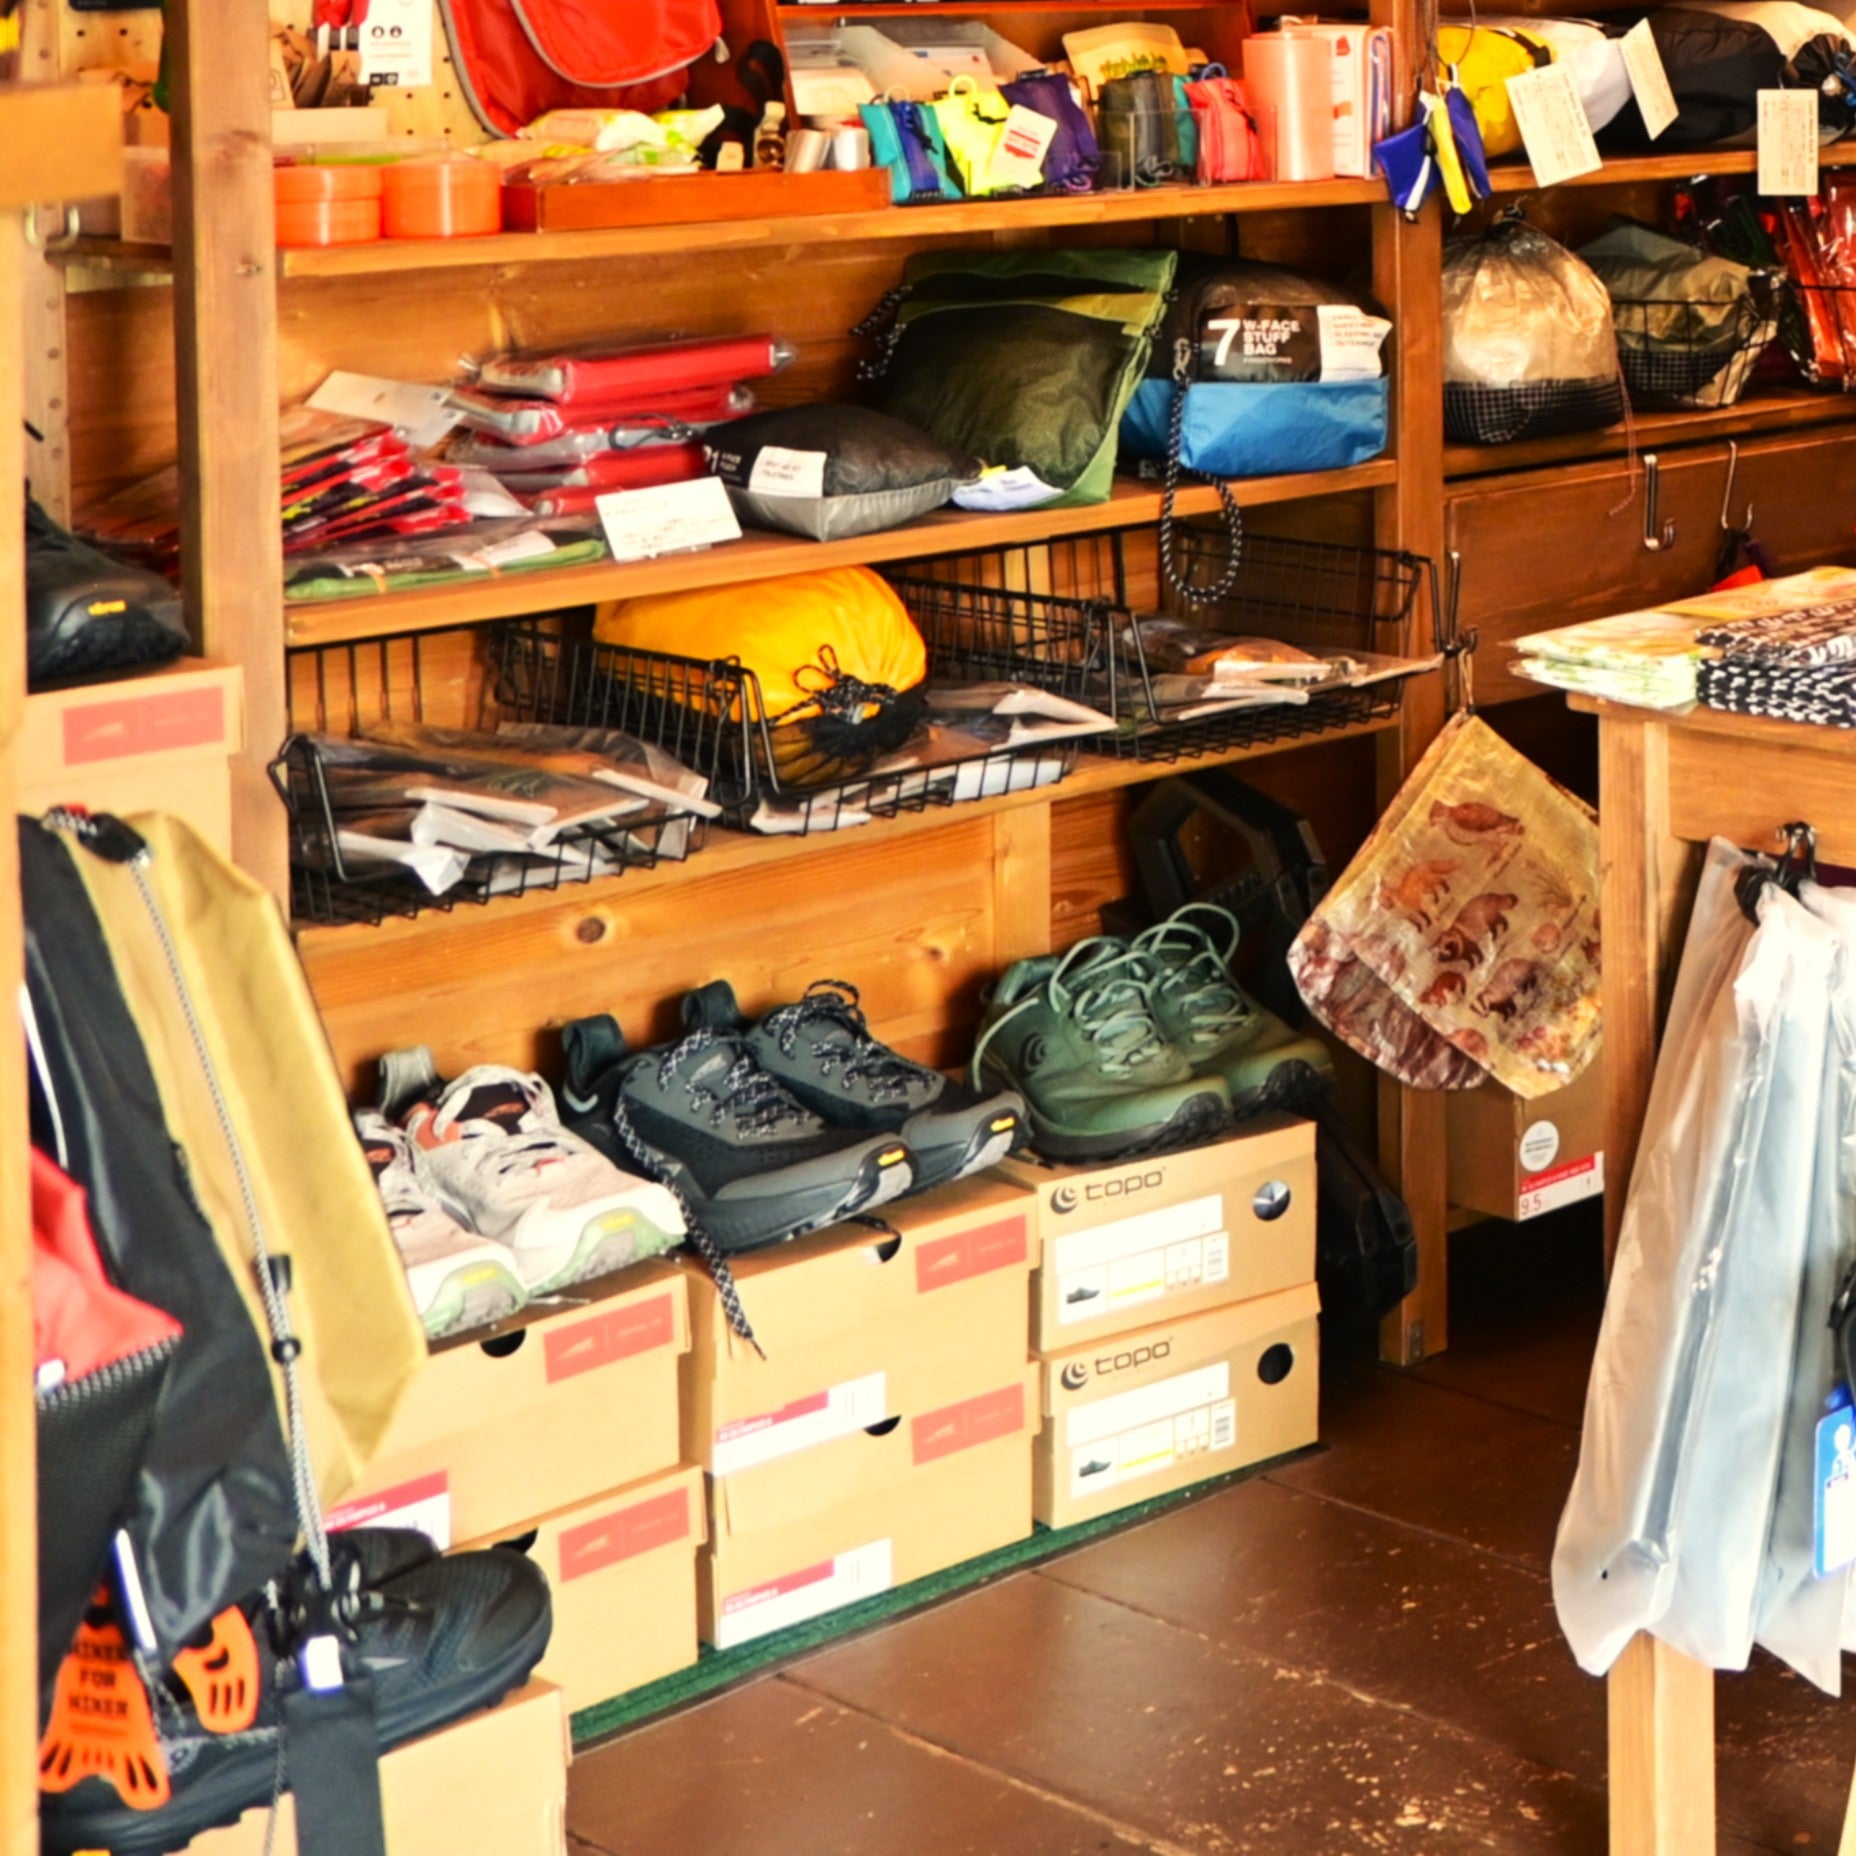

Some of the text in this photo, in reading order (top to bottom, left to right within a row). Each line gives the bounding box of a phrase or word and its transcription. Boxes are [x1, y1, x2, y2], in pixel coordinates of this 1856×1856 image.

[1242, 319, 1300, 332] W-FACE
[1207, 318, 1241, 367] 7
[1243, 331, 1291, 344] STUFF
[1243, 344, 1277, 356] BAG
[1084, 1170, 1162, 1200] topo
[1094, 1341, 1170, 1376] topo
